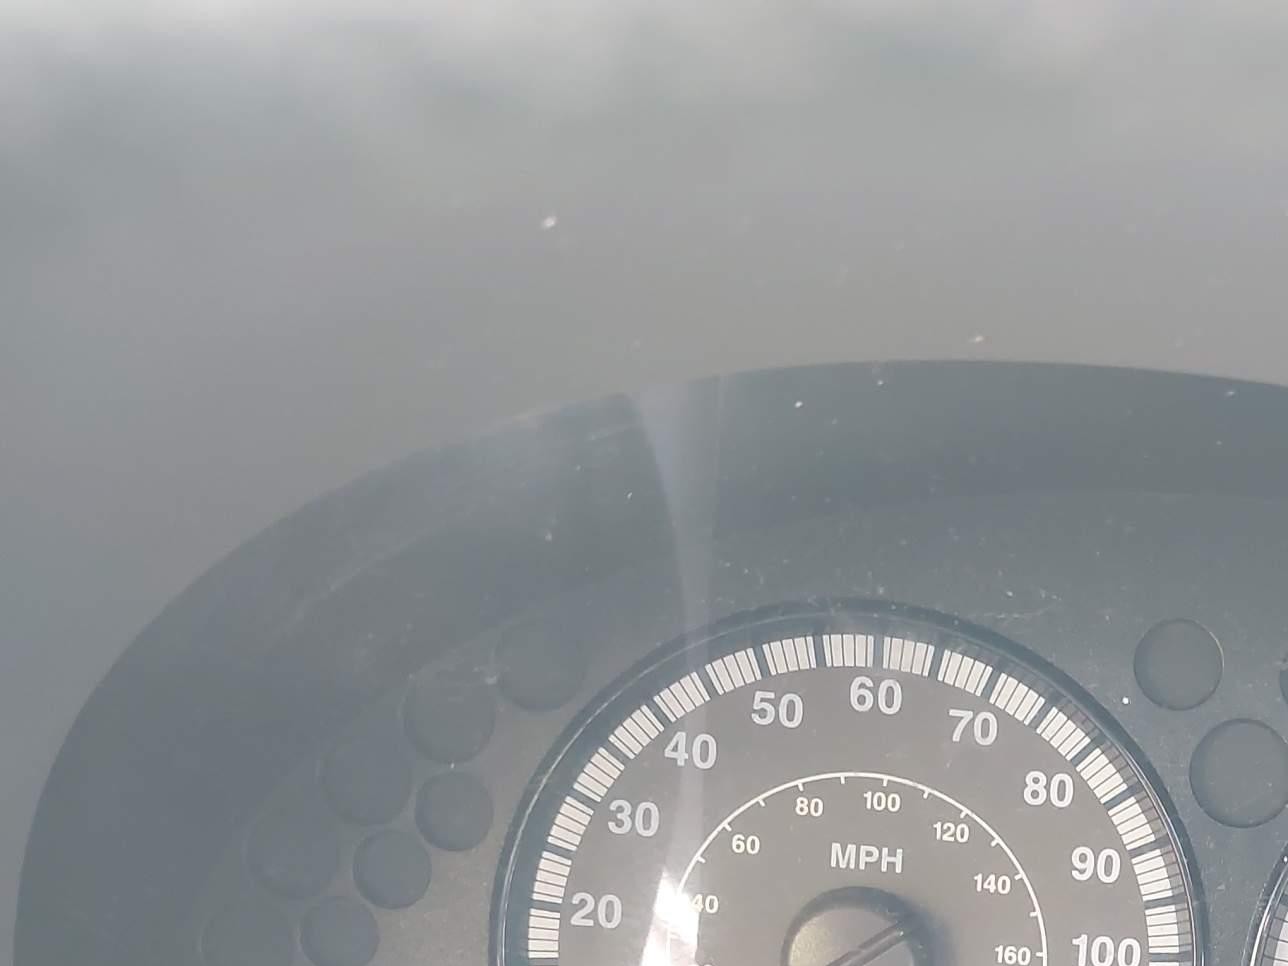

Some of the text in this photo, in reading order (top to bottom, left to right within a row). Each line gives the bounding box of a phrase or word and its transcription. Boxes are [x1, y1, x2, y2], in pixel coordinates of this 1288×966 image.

[751, 690, 803, 728] 50
[849, 676, 903, 715] 60
[948, 709, 999, 746] 70
[664, 731, 717, 769] 40
[863, 791, 901, 812] 100
[1023, 770, 1075, 808] 80
[607, 799, 660, 837] 30
[795, 796, 824, 817] 80
[731, 833, 760, 855] 60
[933, 821, 970, 843] 120
[830, 842, 903, 874] MPH
[1071, 846, 1121, 884] 90
[973, 873, 1011, 895] 140
[570, 892, 622, 929] 20
[690, 894, 719, 914] 40
[994, 944, 1031, 966] 160
